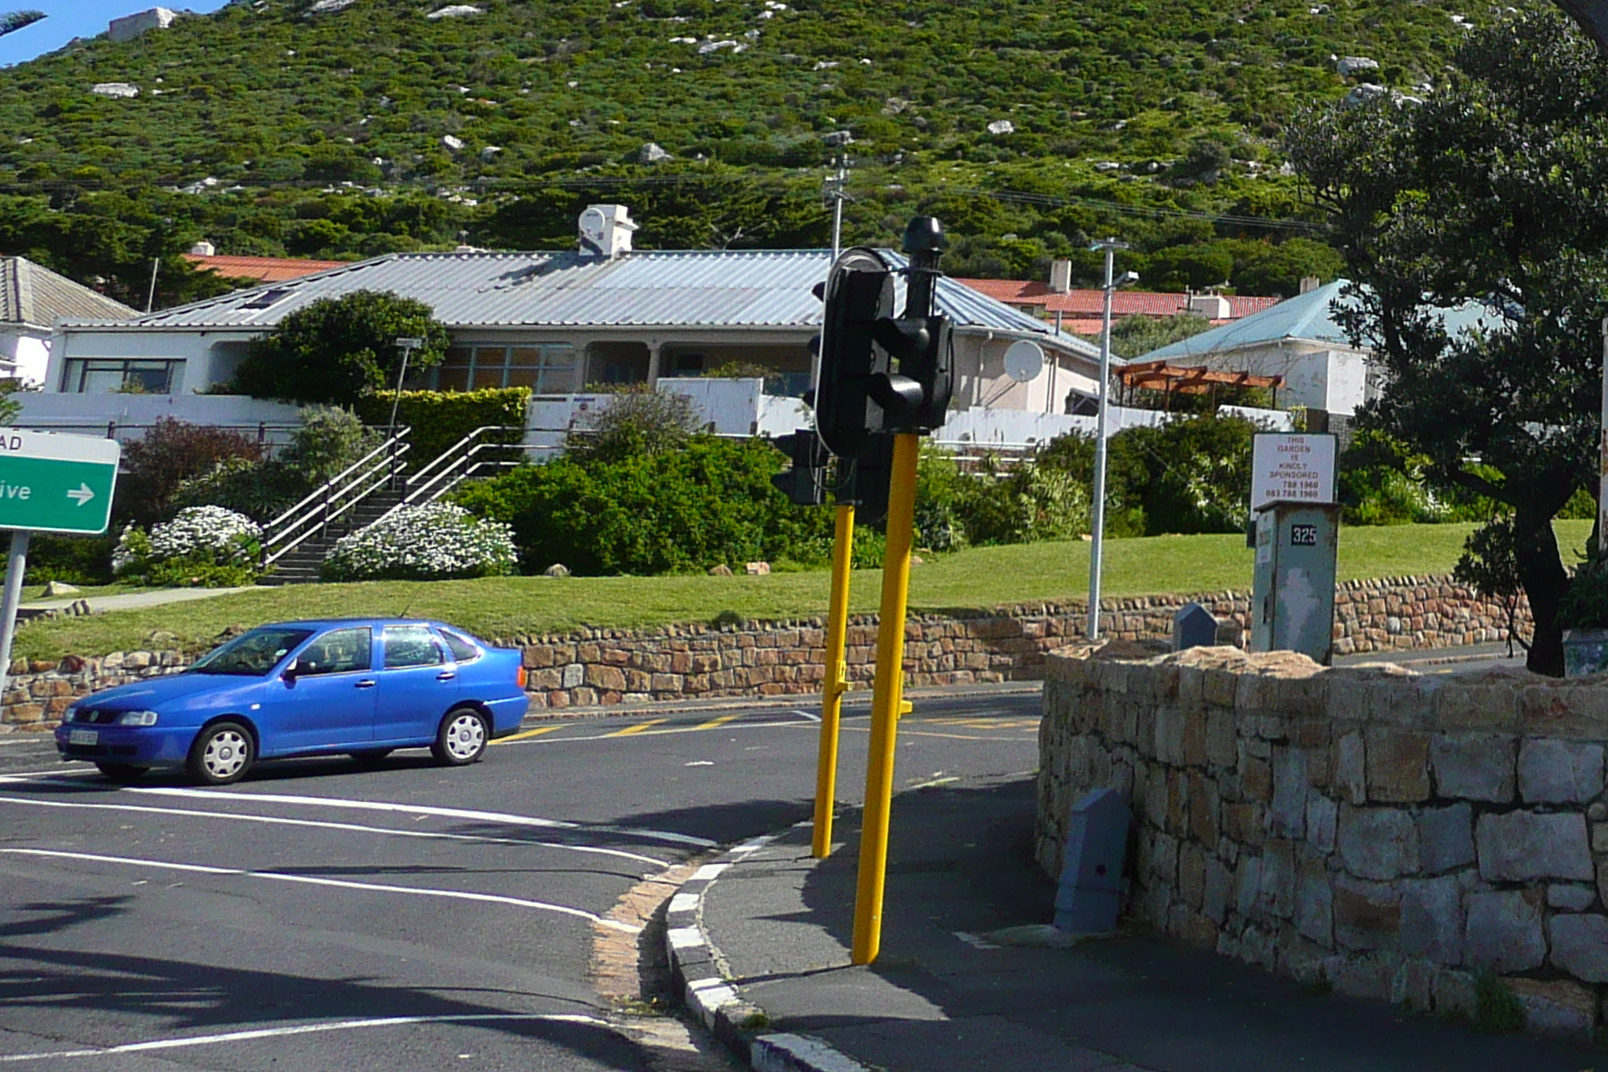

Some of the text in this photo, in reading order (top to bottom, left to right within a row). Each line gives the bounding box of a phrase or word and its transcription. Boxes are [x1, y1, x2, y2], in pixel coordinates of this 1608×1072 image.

[1287, 436, 1305, 444] THIS
[1277, 445, 1311, 453] GARDEN
[1269, 471, 1319, 479] SPONSORED
[1293, 527, 1317, 543] 325
